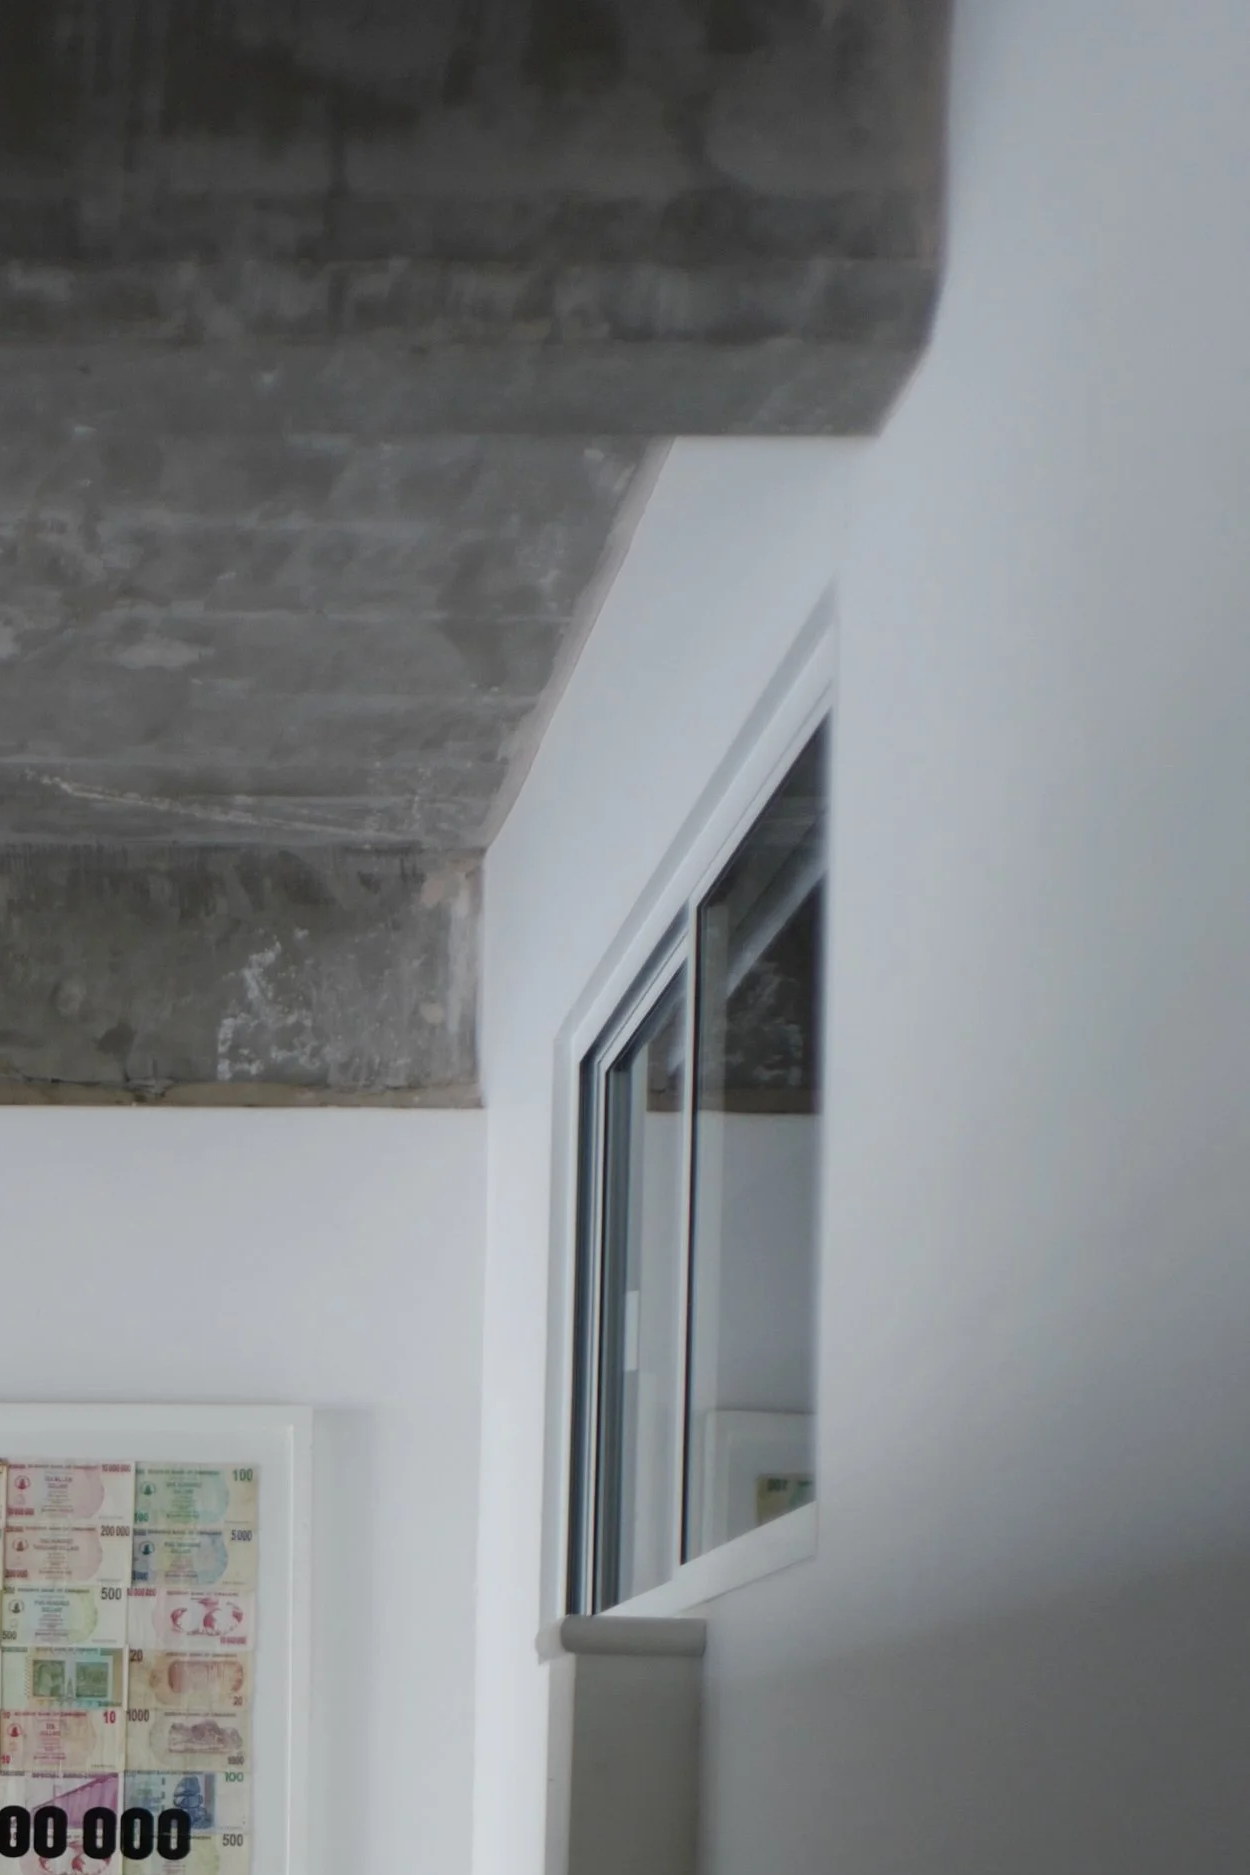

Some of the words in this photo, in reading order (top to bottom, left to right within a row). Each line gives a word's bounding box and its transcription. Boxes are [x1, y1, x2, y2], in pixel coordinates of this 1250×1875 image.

[233, 1469, 253, 1481] 100
[101, 1587, 122, 1600] 500
[130, 1649, 143, 1662] 20
[103, 1711, 116, 1724] 10
[127, 1709, 149, 1722] 1000
[225, 1772, 244, 1783] 100
[83, 1806, 191, 1861] 000
[222, 1834, 244, 1847] 500
